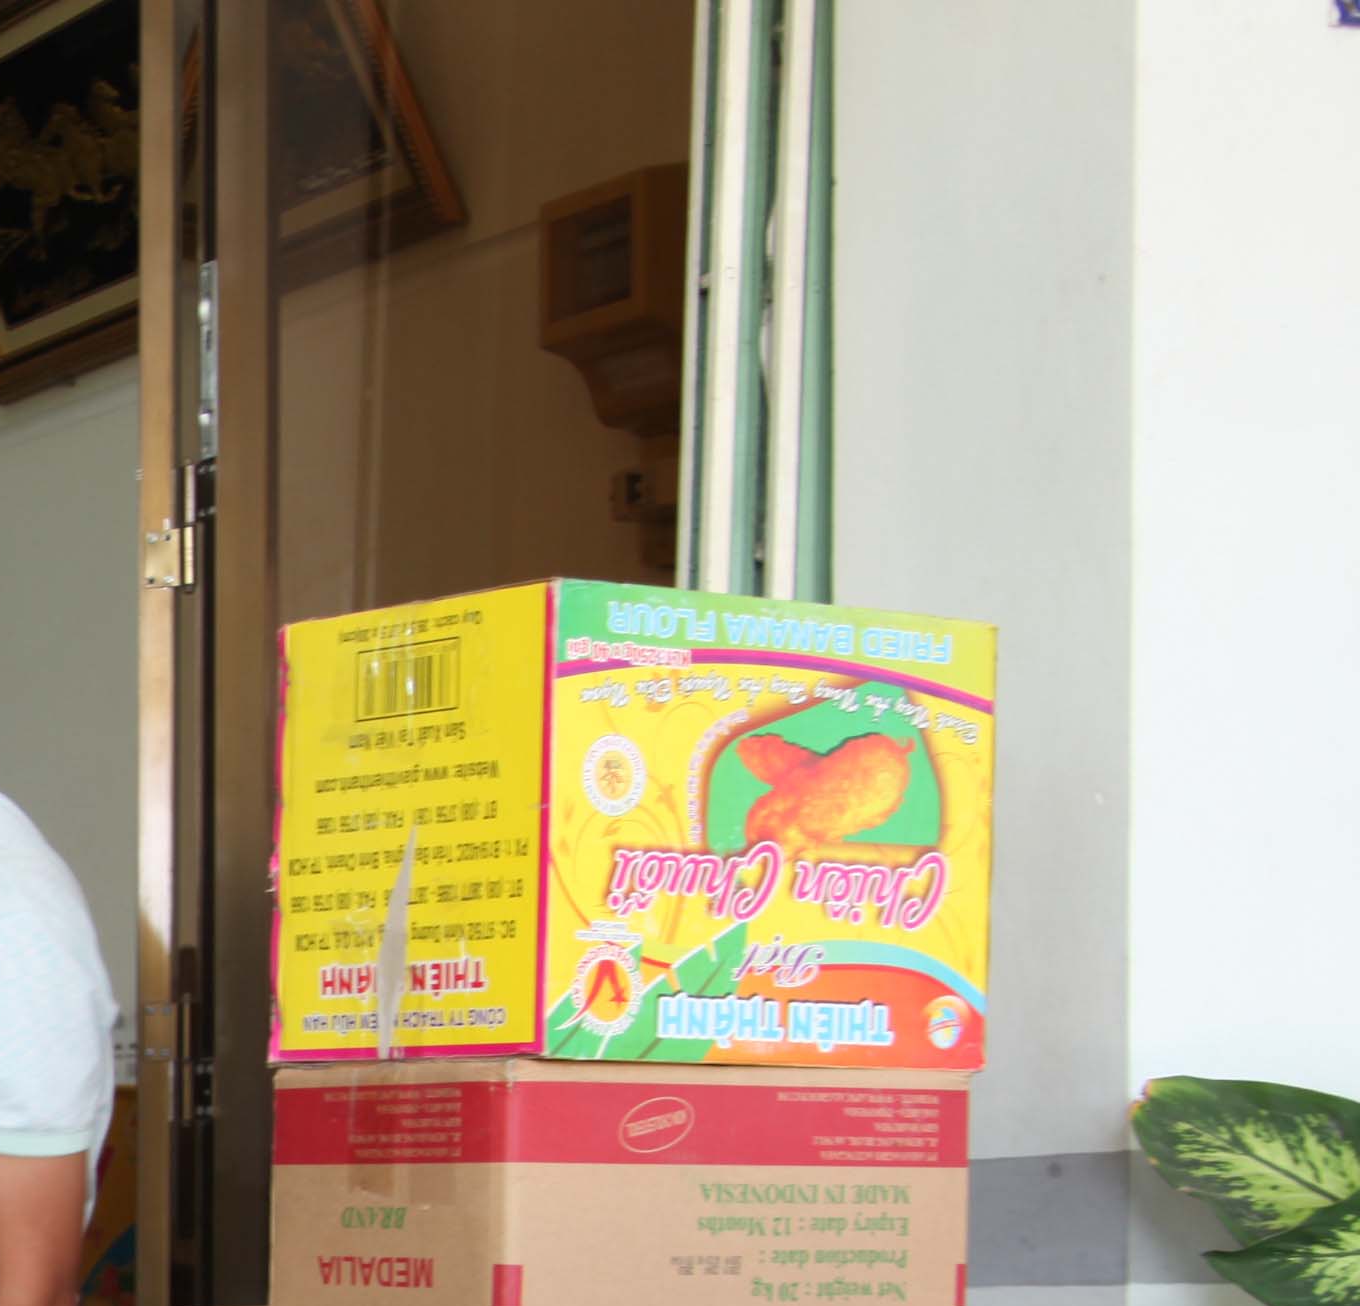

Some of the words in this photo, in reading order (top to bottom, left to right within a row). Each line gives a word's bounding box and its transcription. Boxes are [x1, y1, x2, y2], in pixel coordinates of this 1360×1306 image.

[608, 601, 716, 642] FLOUR
[724, 612, 854, 654] BANANA
[863, 626, 952, 663] FRIED
[607, 842, 780, 923] Chuối
[791, 852, 946, 929] Chiên
[409, 957, 486, 998] THIÊN
[788, 1000, 892, 1052] THIÊN
[700, 1182, 819, 1205] INDONESIA
[822, 1184, 847, 1206] IN
[850, 1184, 910, 1206] MADE
[341, 1206, 407, 1229] BRAND
[698, 1216, 767, 1237] Months
[772, 1216, 792, 1236] 12
[809, 1216, 847, 1236] date
[852, 1212, 909, 1237] Expiry
[814, 1247, 908, 1269] Production
[318, 1255, 433, 1288] MEDALIA
[751, 1278, 775, 1301] kg
[779, 1282, 798, 1301] 20
[816, 1278, 873, 1301] weight
[876, 1281, 907, 1301] Net
